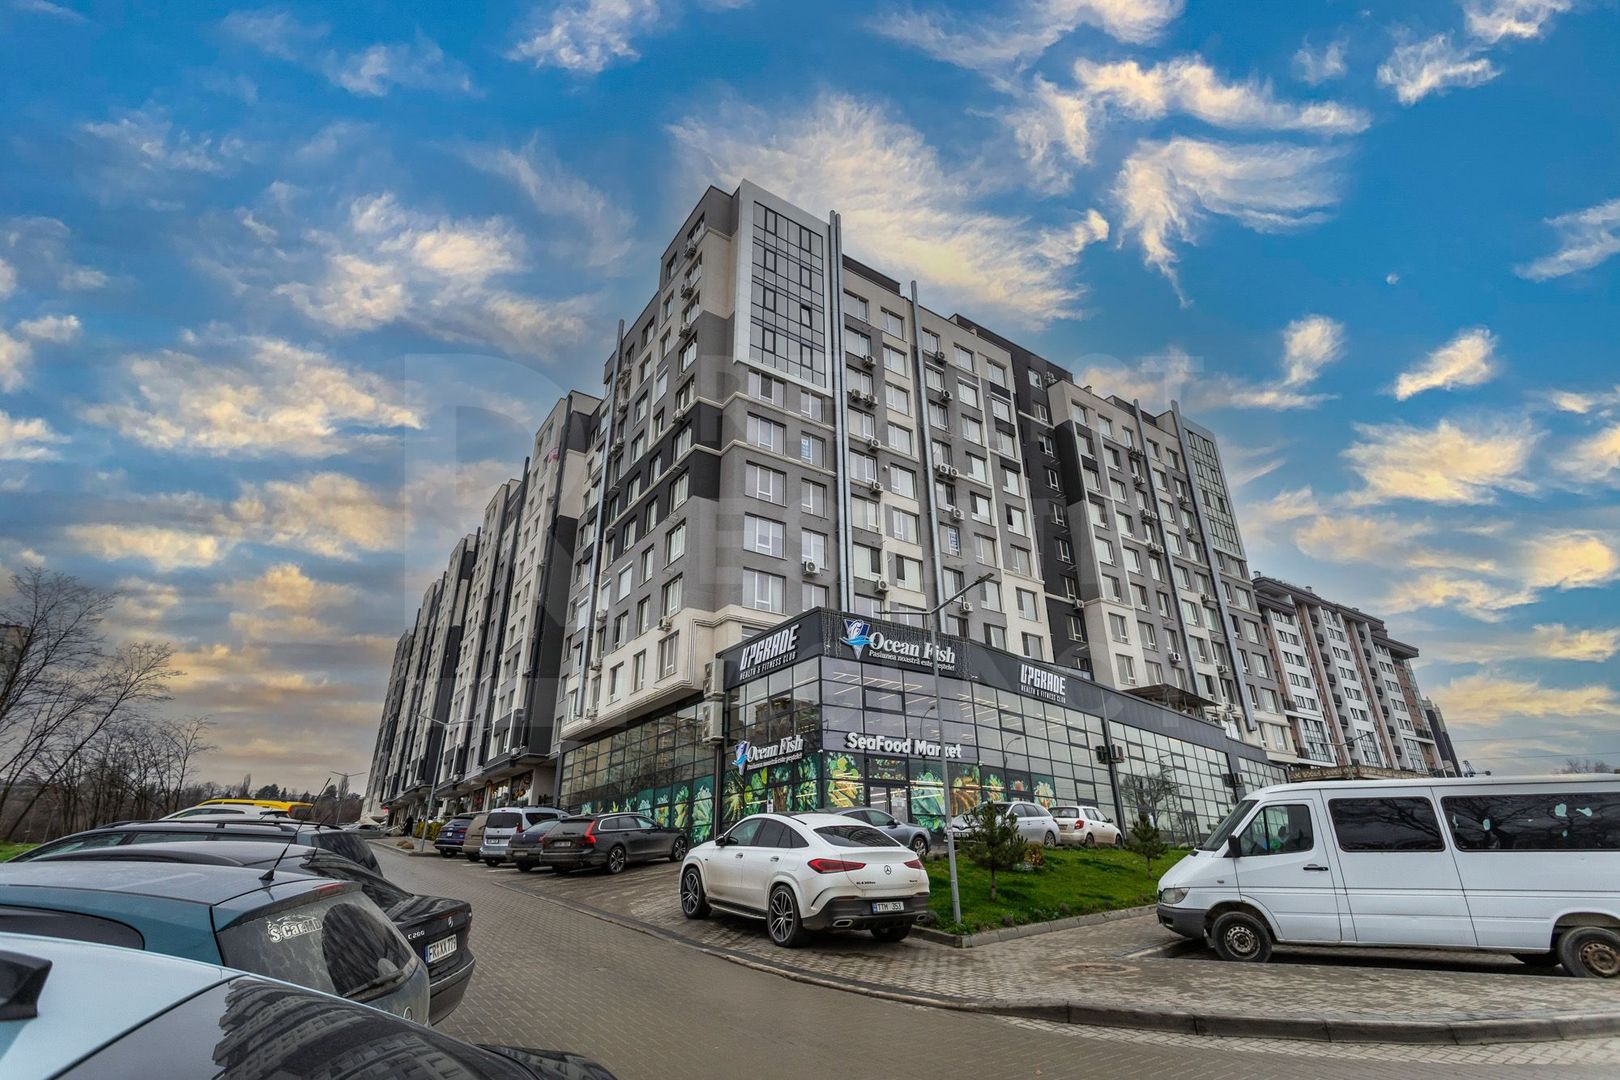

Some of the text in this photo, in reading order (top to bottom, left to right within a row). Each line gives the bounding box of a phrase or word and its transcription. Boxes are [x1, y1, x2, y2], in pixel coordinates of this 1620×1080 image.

[740, 624, 799, 671] UPGRADE
[761, 658, 782, 672] FITNESS
[783, 652, 796, 663] CLUB
[869, 632, 955, 663] Ocean Fish
[1020, 664, 1065, 695] UPGRADE
[747, 744, 779, 762] Ocean
[779, 734, 804, 755] Fish
[847, 732, 911, 754] SeaFood
